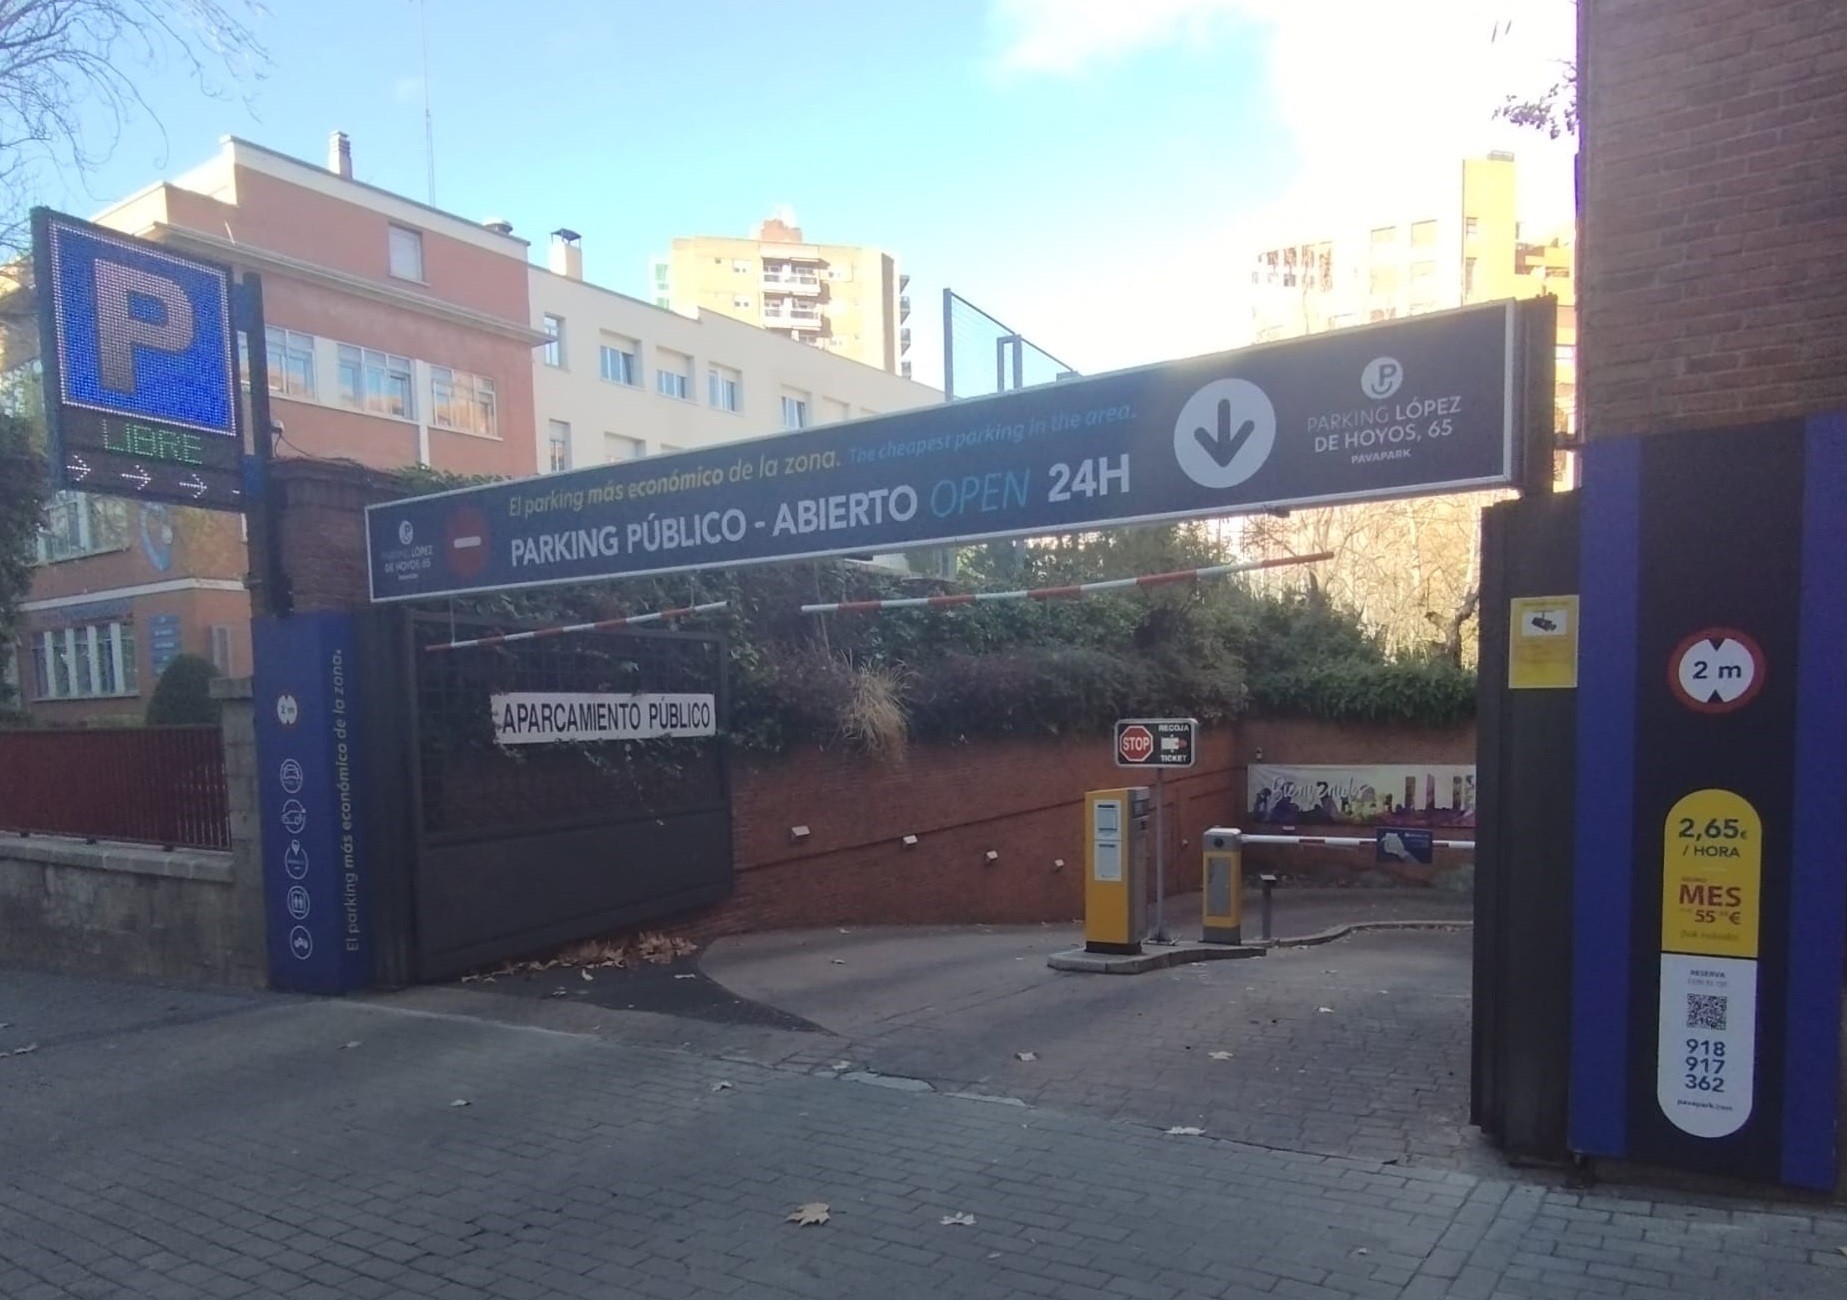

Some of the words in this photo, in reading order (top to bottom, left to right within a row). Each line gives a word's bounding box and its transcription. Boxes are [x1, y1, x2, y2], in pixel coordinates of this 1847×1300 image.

[95, 258, 194, 394] P
[1307, 406, 1389, 433] PARKING
[1395, 396, 1462, 420] LÓPEZ
[102, 419, 202, 464] LIBRE
[849, 446, 876, 463] The
[879, 433, 951, 458] cheapest
[954, 422, 1025, 452] parking
[1029, 416, 1047, 437] in
[1051, 410, 1080, 431] the
[1314, 434, 1339, 452] DE
[1344, 423, 1422, 449] HOYOS,
[1428, 419, 1453, 438] 65
[1351, 449, 1411, 464] PAVAPARK
[509, 494, 521, 517] El
[525, 489, 584, 520] parking
[588, 480, 624, 503] más
[628, 465, 724, 498] económico
[728, 457, 753, 482] de
[759, 453, 779, 478] la
[785, 450, 841, 474] zona.
[511, 525, 619, 568] PARKING
[626, 513, 747, 554] PÚBLICO
[772, 485, 918, 537] ABIERTO
[930, 468, 1031, 518] OPEN
[1048, 453, 1130, 503] 24H
[332, 649, 344, 696] zona.
[1693, 661, 1708, 679] 2
[1718, 664, 1742, 679] m
[331, 699, 345, 714] la
[502, 703, 641, 734] APARCAMIENTO
[649, 696, 711, 729] PÚBLICO
[333, 719, 347, 739] de
[1122, 736, 1150, 751] STOP
[1160, 754, 1187, 762] TICKET
[335, 743, 352, 831] económico
[340, 834, 354, 869] más
[1694, 845, 1740, 858] HORA
[343, 872, 359, 934] parking
[1679, 883, 1742, 908] MES
[1695, 909, 1716, 924] 55
[345, 938, 359, 951] El
[1686, 1038, 1726, 1057] 918
[1685, 1056, 1725, 1074] 917
[1684, 1074, 1725, 1093] 362
